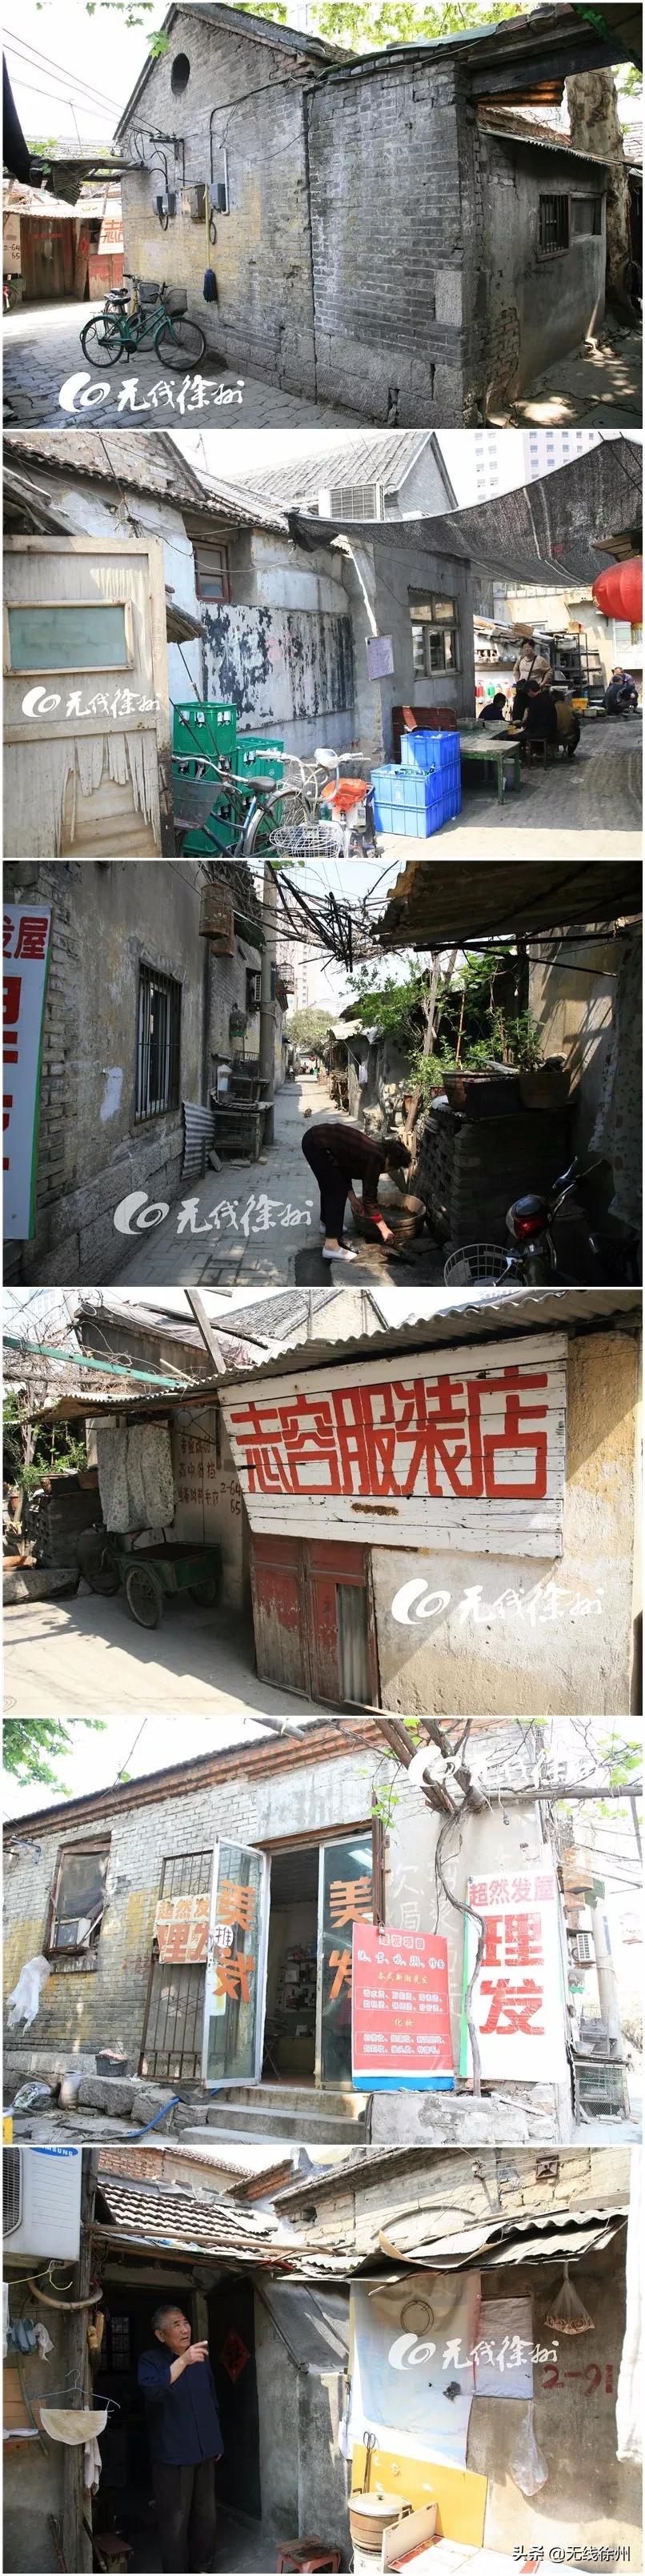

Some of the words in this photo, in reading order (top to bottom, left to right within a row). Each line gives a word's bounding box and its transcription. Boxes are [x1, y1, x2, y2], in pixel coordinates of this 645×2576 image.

[230, 1367, 549, 1499] 志容服装店
[220, 1480, 241, 1497] 2-64
[230, 1499, 241, 1516] 65
[469, 1876, 555, 1907] 超然发屋
[215, 1925, 232, 1947] 推
[379, 1934, 425, 1950] 经营项目
[479, 1912, 545, 2036] 理发
